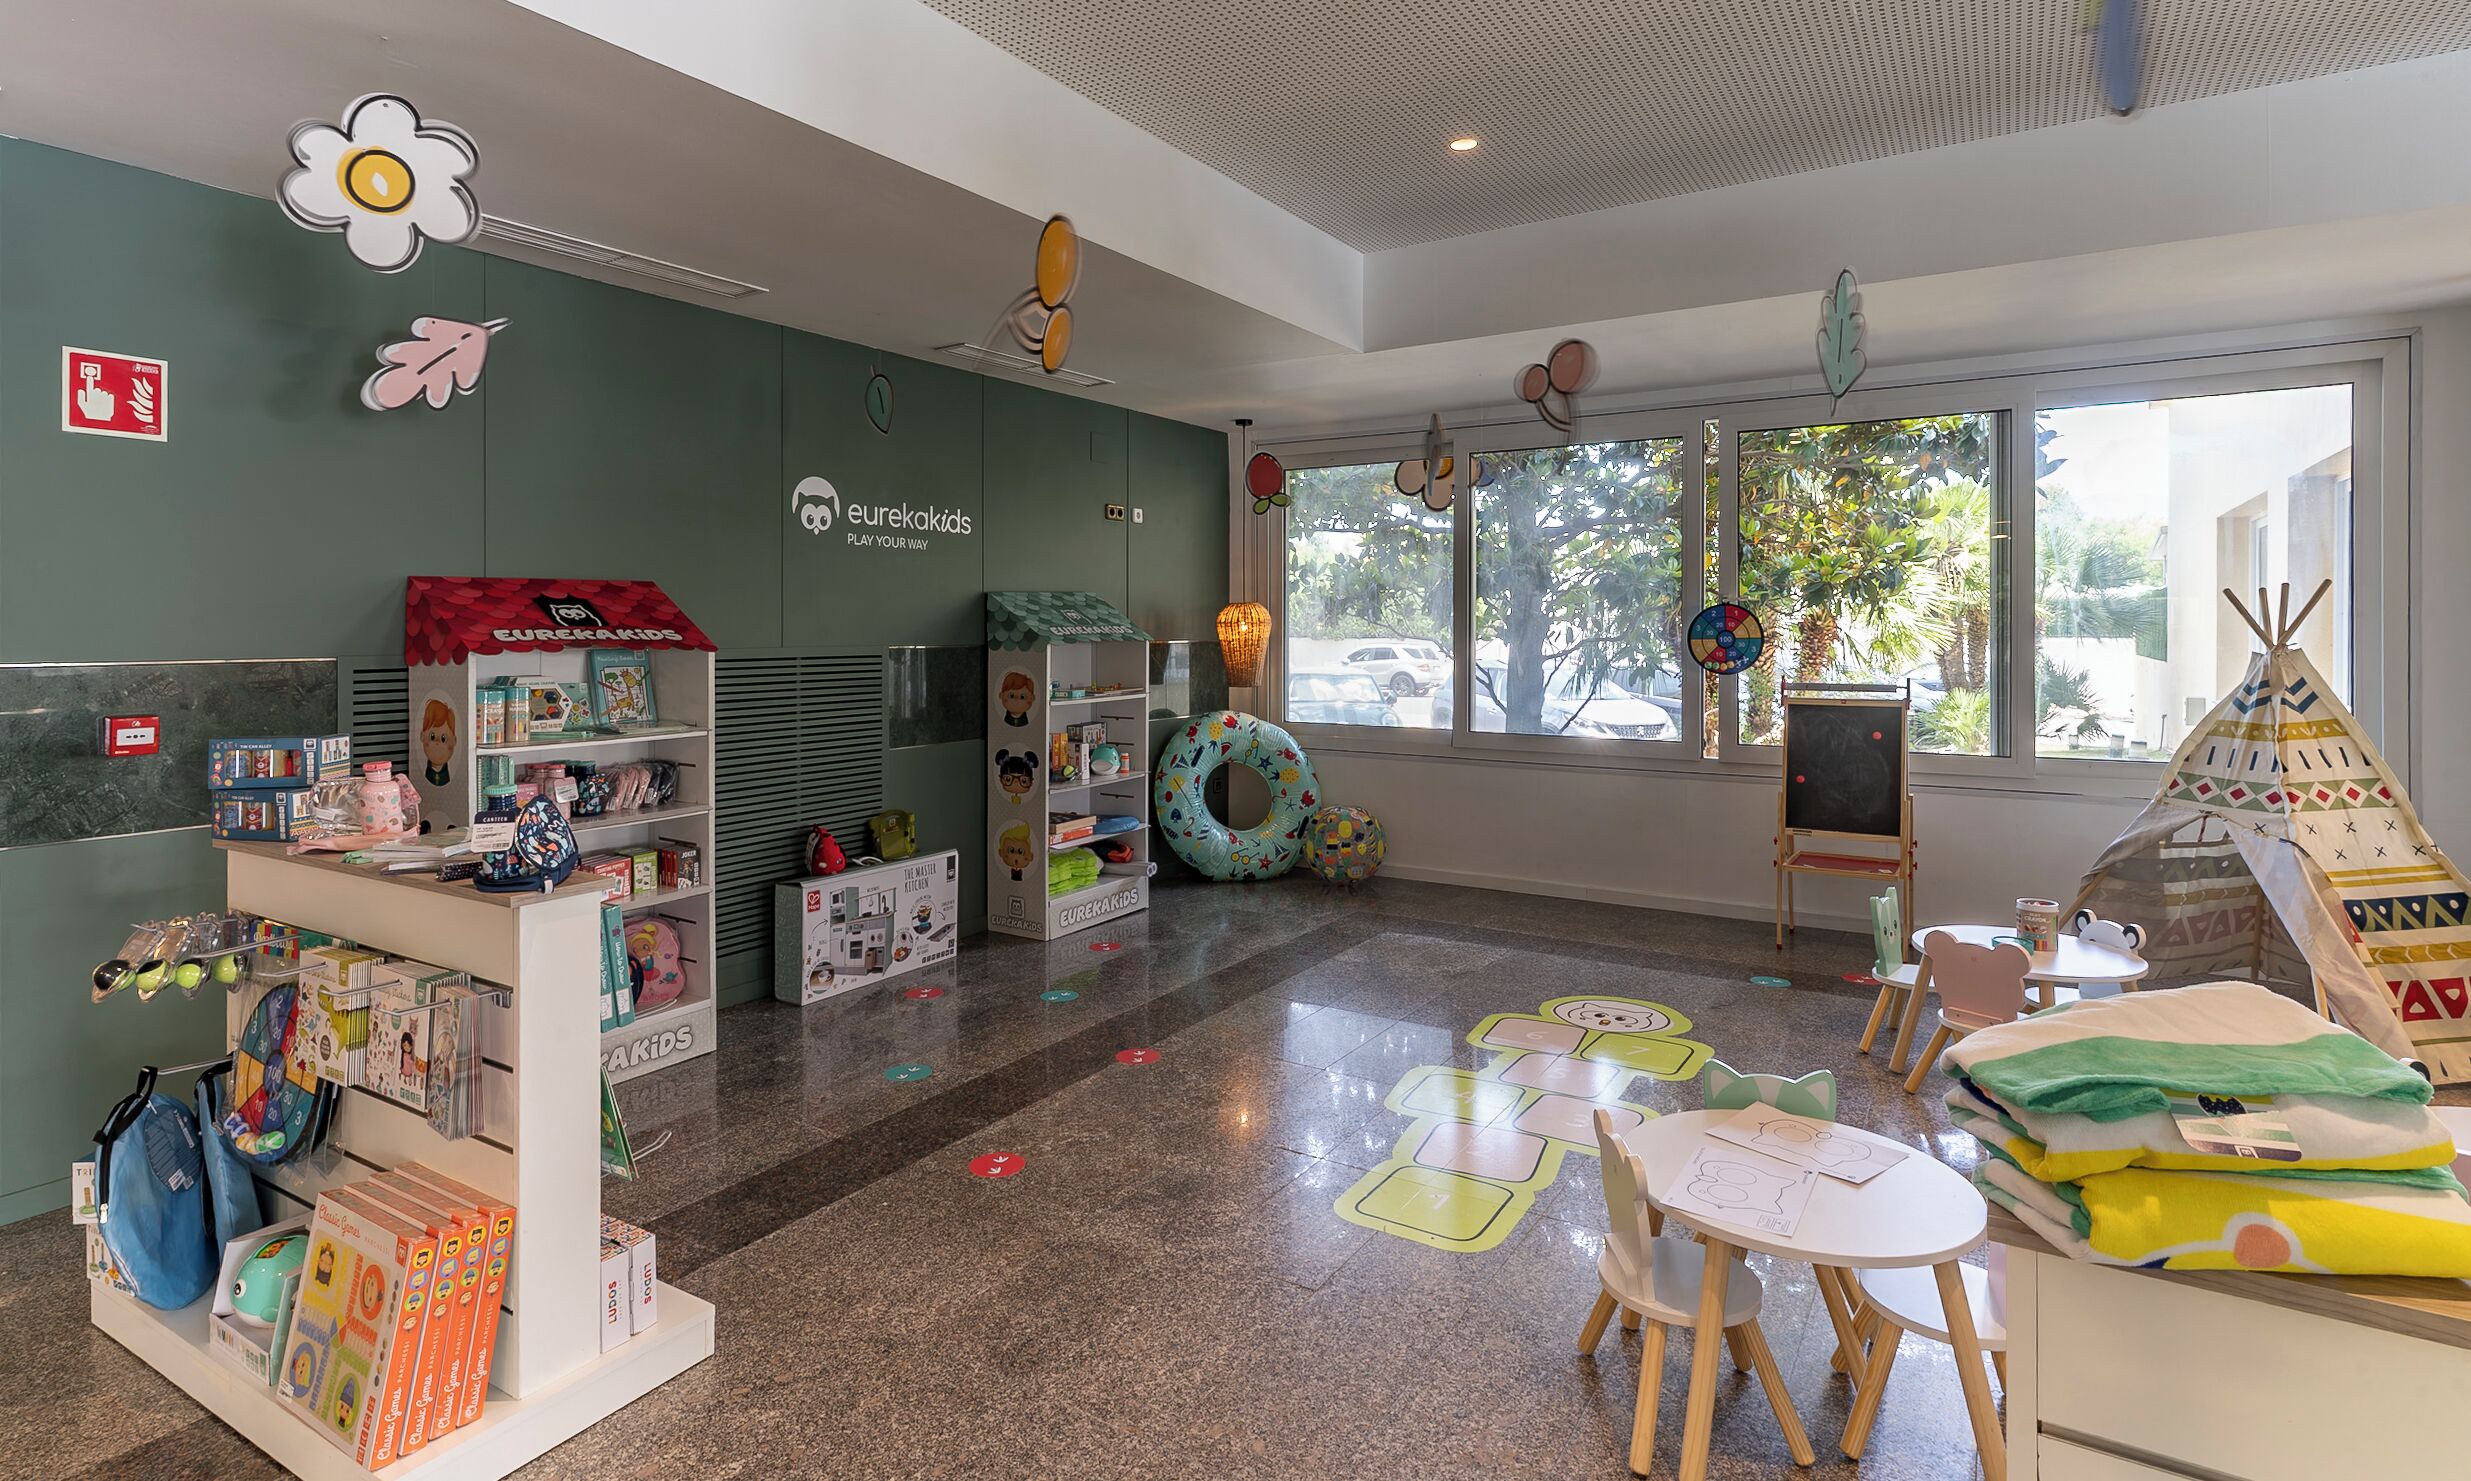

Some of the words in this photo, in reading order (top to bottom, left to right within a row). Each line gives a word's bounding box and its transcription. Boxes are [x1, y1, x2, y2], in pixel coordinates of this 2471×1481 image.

[848, 503, 972, 535] eurekakids
[847, 533, 875, 546] PLAY
[876, 534, 906, 549] YOUR
[907, 538, 929, 550] WAY
[681, 849, 697, 859] JOKER
[904, 867, 914, 881] THE
[915, 862, 936, 878] MASTER
[905, 877, 929, 893] KITCHEN
[275, 995, 284, 1009] 2
[251, 1020, 257, 1034] 3
[1526, 1031, 1544, 1040] 6
[1625, 1045, 1649, 1057] 7
[267, 1065, 282, 1080] 100
[254, 1100, 263, 1112] 10
[283, 1091, 293, 1105] 30
[268, 1107, 277, 1121] 20
[294, 1111, 301, 1126] 3
[319, 1203, 341, 1228] Classic
[341, 1215, 361, 1238] Games
[644, 1262, 652, 1305] LUDOS
[608, 1280, 618, 1325] LUDOS
[471, 1346, 487, 1380] Games
[444, 1359, 461, 1393] Games
[416, 1372, 433, 1407] Games
[384, 1386, 402, 1422] Games
[465, 1380, 481, 1419] Classic
[438, 1391, 455, 1429] Classic
[409, 1406, 427, 1445] Classic
[377, 1421, 396, 1460] Classic
